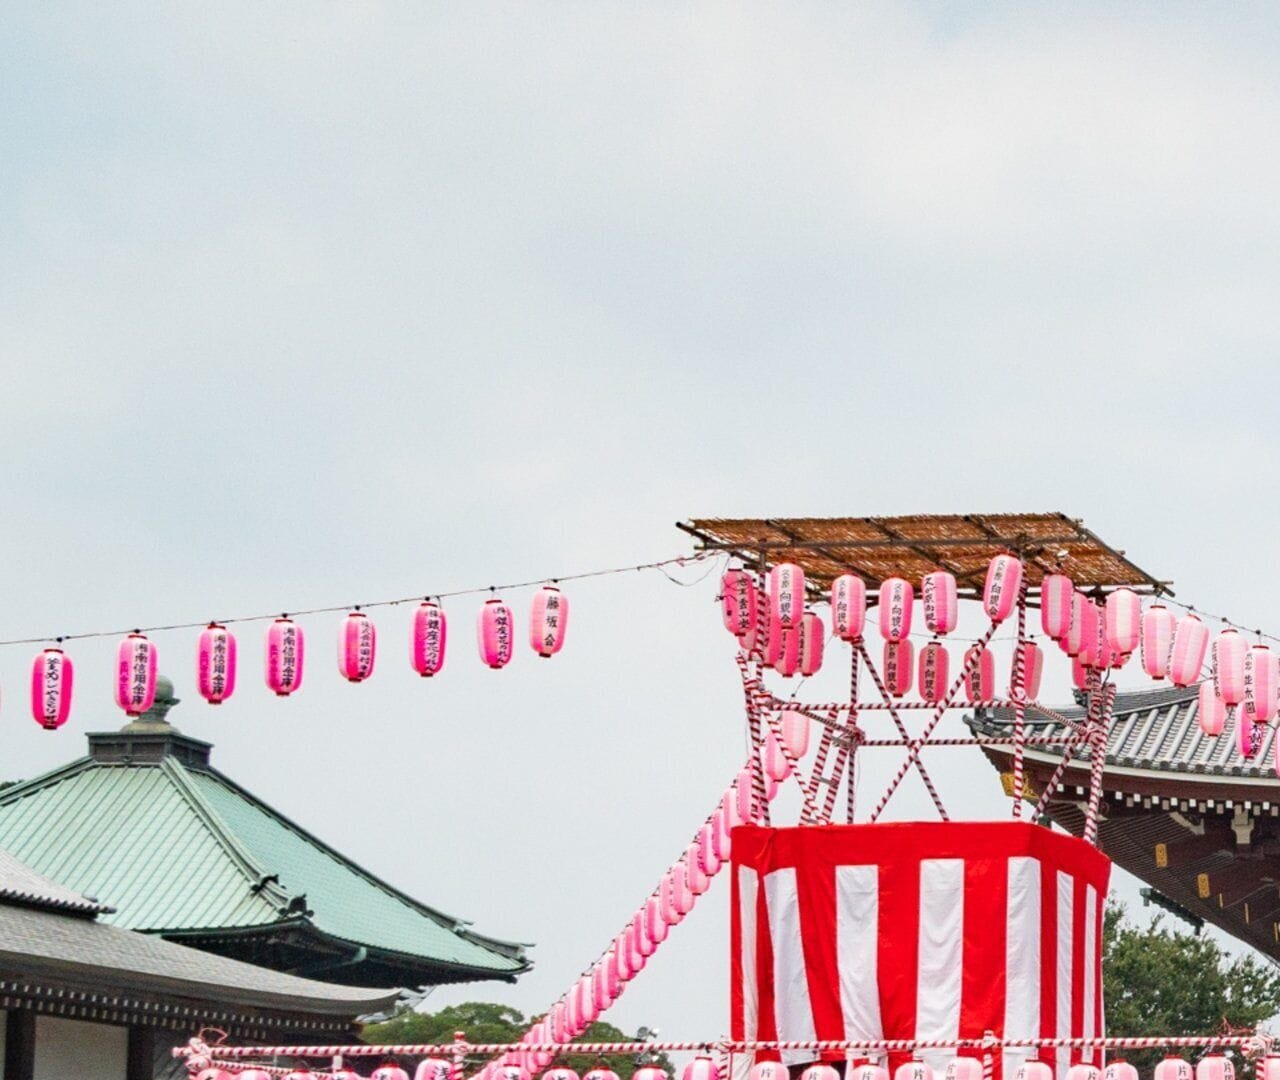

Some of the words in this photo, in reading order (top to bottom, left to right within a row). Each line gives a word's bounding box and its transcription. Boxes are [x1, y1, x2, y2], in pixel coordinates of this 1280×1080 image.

[545, 596, 560, 648] 藤坂会
[132, 642, 148, 706] 湘南信用金庫
[210, 633, 226, 695] 湘南信用金庫
[279, 626, 296, 688] 湘南信用金庫
